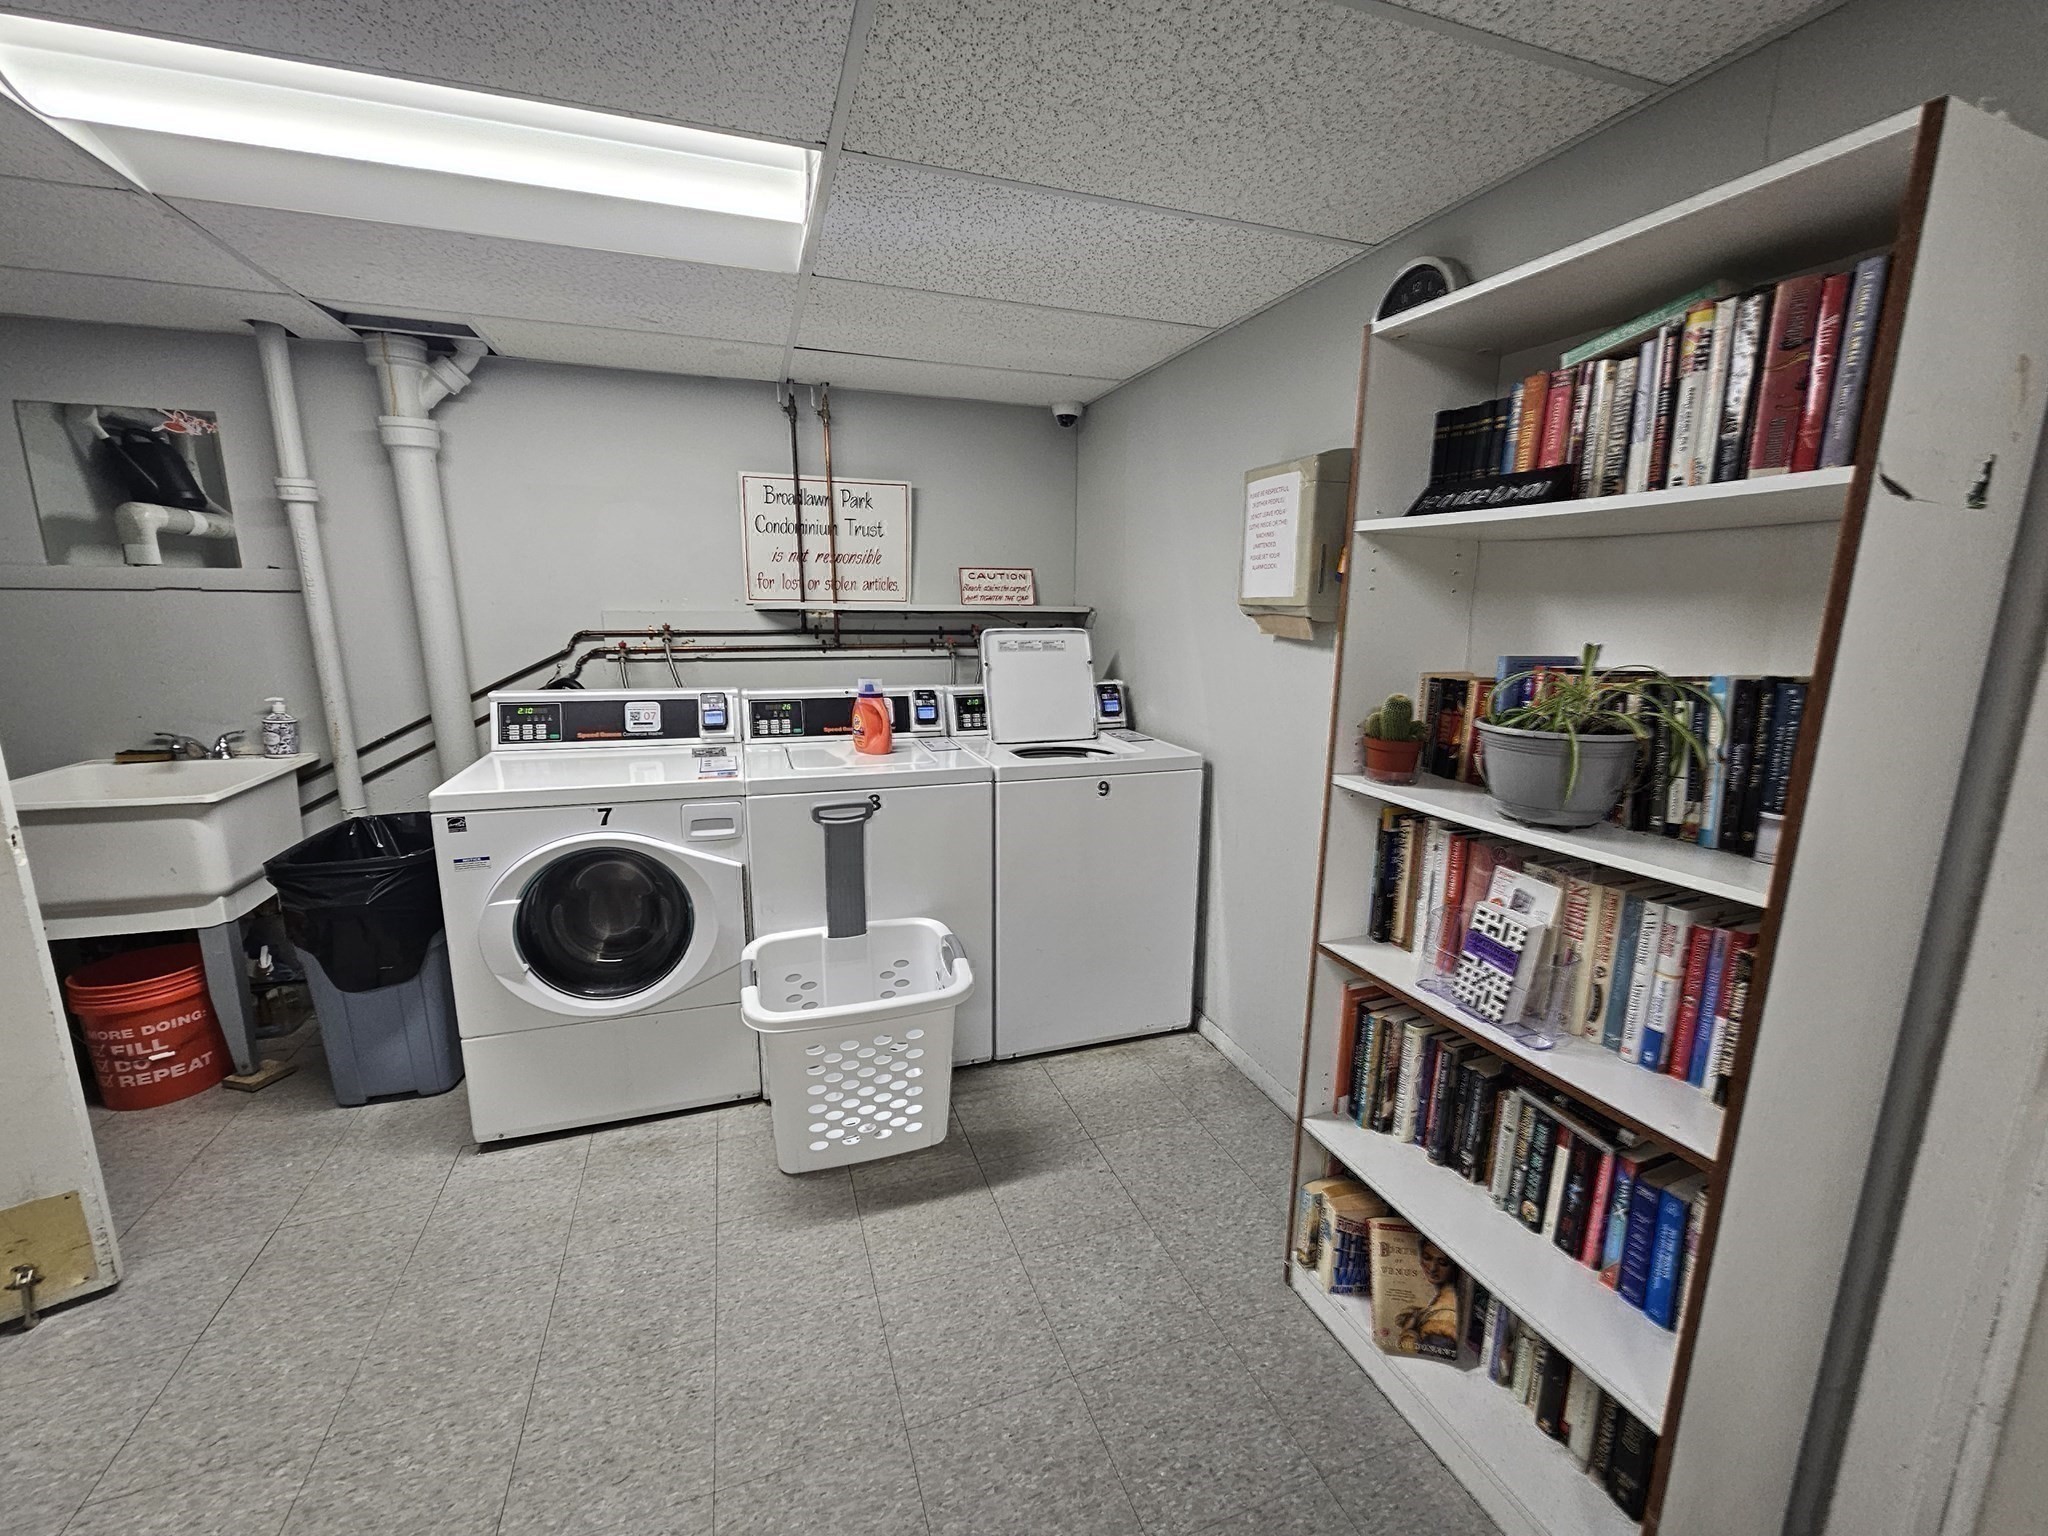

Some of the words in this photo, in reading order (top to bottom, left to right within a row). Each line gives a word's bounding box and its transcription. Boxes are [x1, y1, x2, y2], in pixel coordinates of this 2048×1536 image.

[840, 489, 873, 509] Park
[844, 518, 884, 538] Trust
[772, 547, 784, 562] is
[757, 572, 775, 590] for
[808, 579, 821, 590] or
[862, 577, 900, 592] articles.
[968, 572, 1027, 580] CAUTION
[643, 711, 657, 720] 07
[1097, 781, 1110, 797] 9
[597, 807, 613, 826] 7
[1635, 919, 1655, 966] Warning
[141, 1010, 208, 1036] DOING:
[110, 1038, 170, 1057] FILL
[119, 1051, 213, 1088] REPEAT
[1381, 1266, 1418, 1277] VENUS
